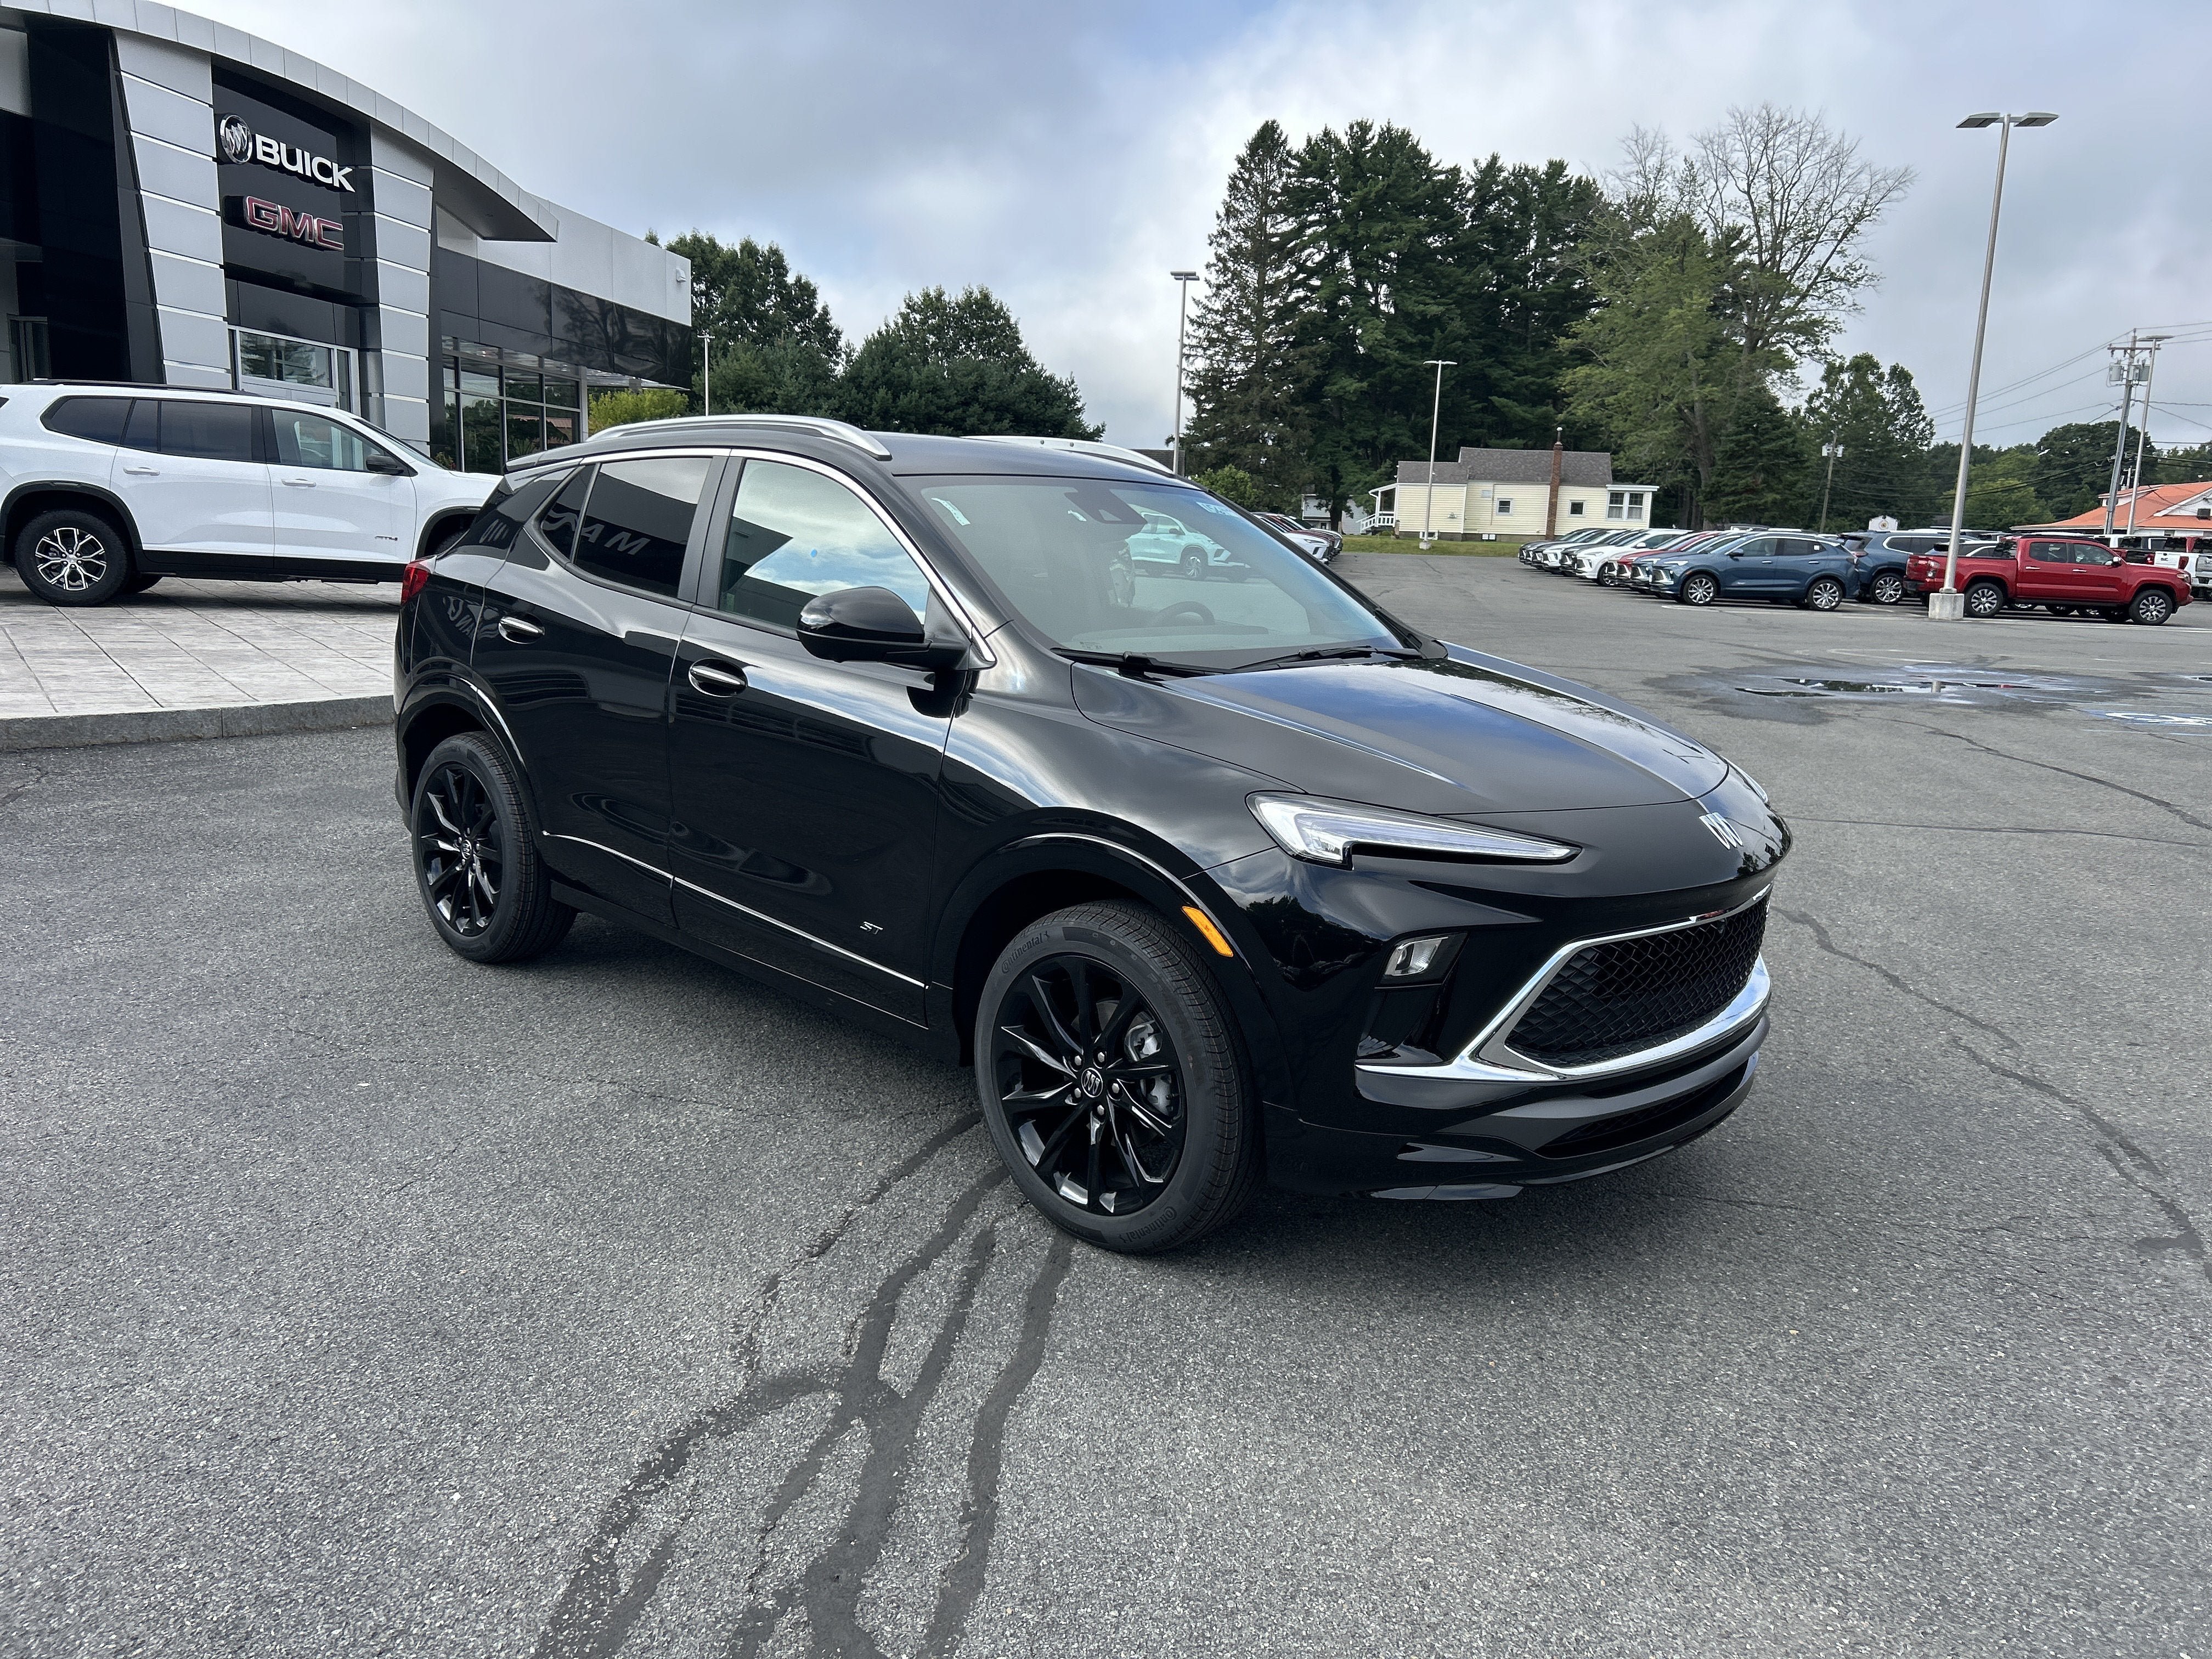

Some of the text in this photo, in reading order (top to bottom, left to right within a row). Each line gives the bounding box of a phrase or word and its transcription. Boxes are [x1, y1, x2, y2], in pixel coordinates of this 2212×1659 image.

[255, 133, 356, 193] BUICK
[246, 196, 345, 251] GMC
[860, 921, 883, 935] ST
[1001, 933, 1043, 974] Continental
[1126, 1205, 1177, 1243] Continental
